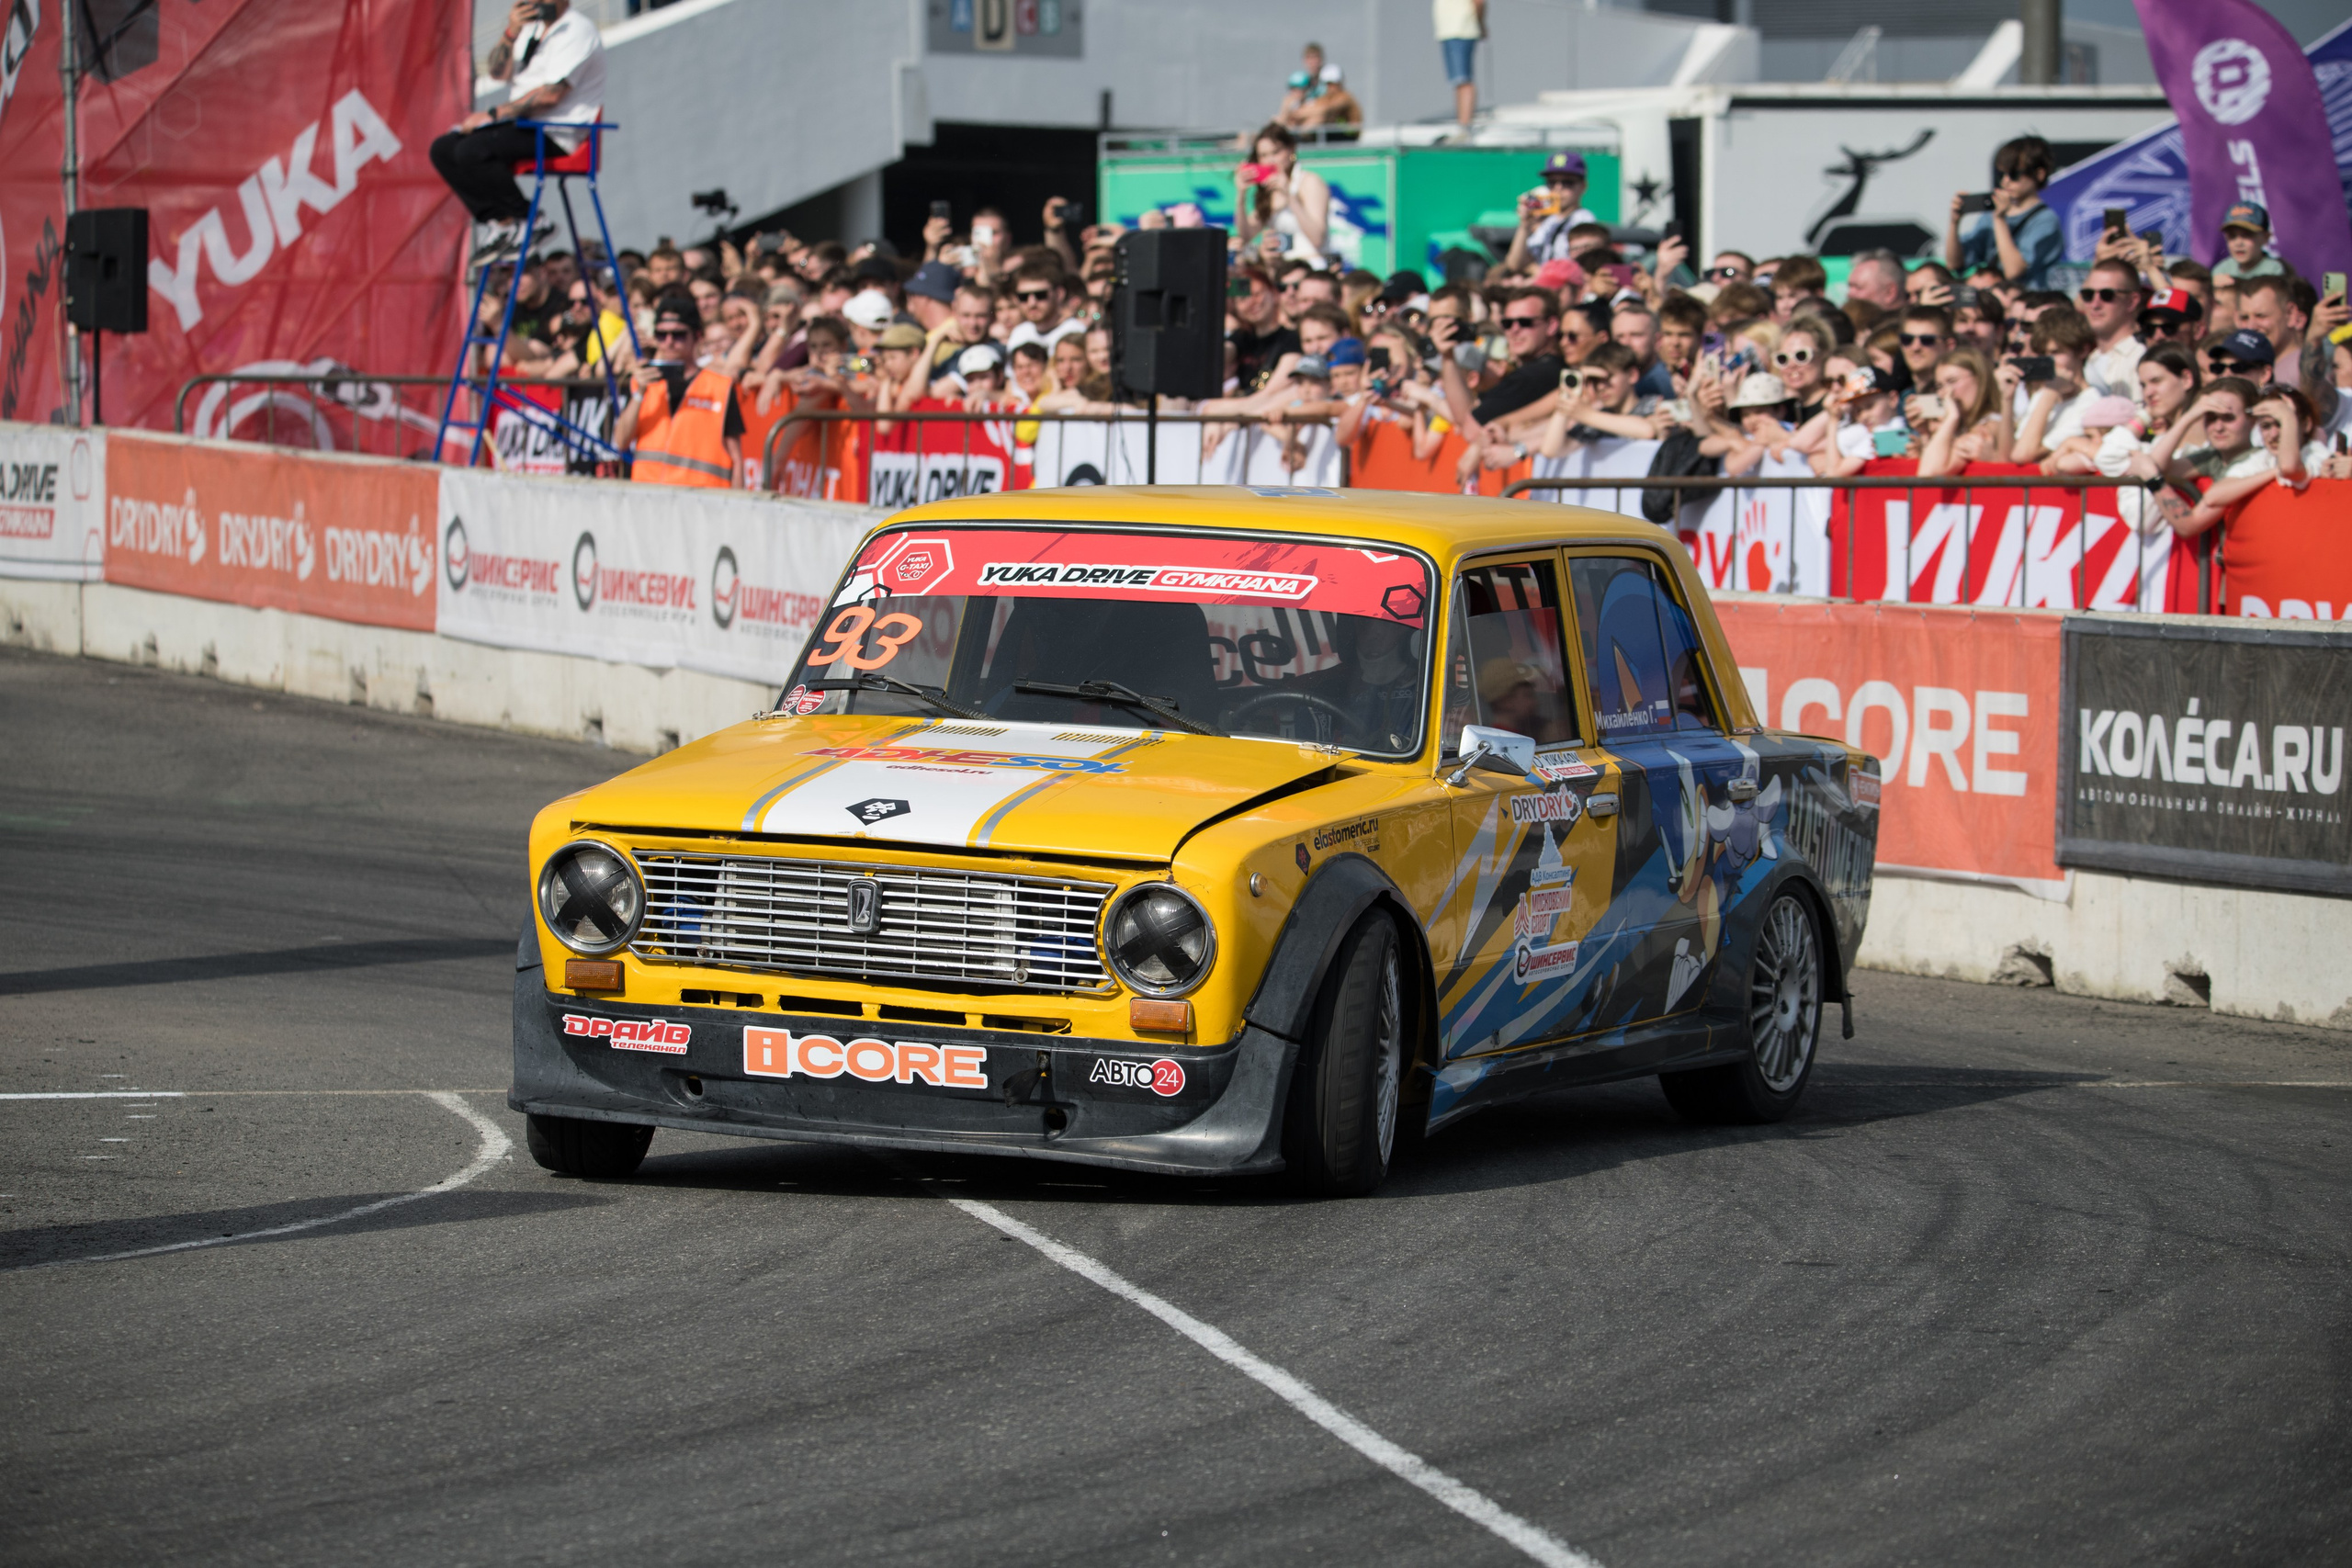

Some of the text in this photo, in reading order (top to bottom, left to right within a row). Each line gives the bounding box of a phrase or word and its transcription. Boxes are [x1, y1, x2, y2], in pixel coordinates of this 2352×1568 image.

[148, 87, 402, 333] YUKA
[1882, 499, 2175, 614] YUKA
[982, 567, 1300, 594] YUKA DRIVE GYMKHANA
[807, 606, 923, 671] 93
[1594, 705, 1657, 730] Михайленко Г.
[885, 764, 994, 775] adhesol.ru
[1511, 797, 1562, 820] DRYDRY
[2079, 787, 2208, 812] АВТОМОБИЛЬНЫЙ
[1314, 816, 1379, 851] elastomeric.ru
[1530, 947, 1576, 971] ШИНСЕРВИС
[564, 1016, 690, 1044] ДРАЙВ
